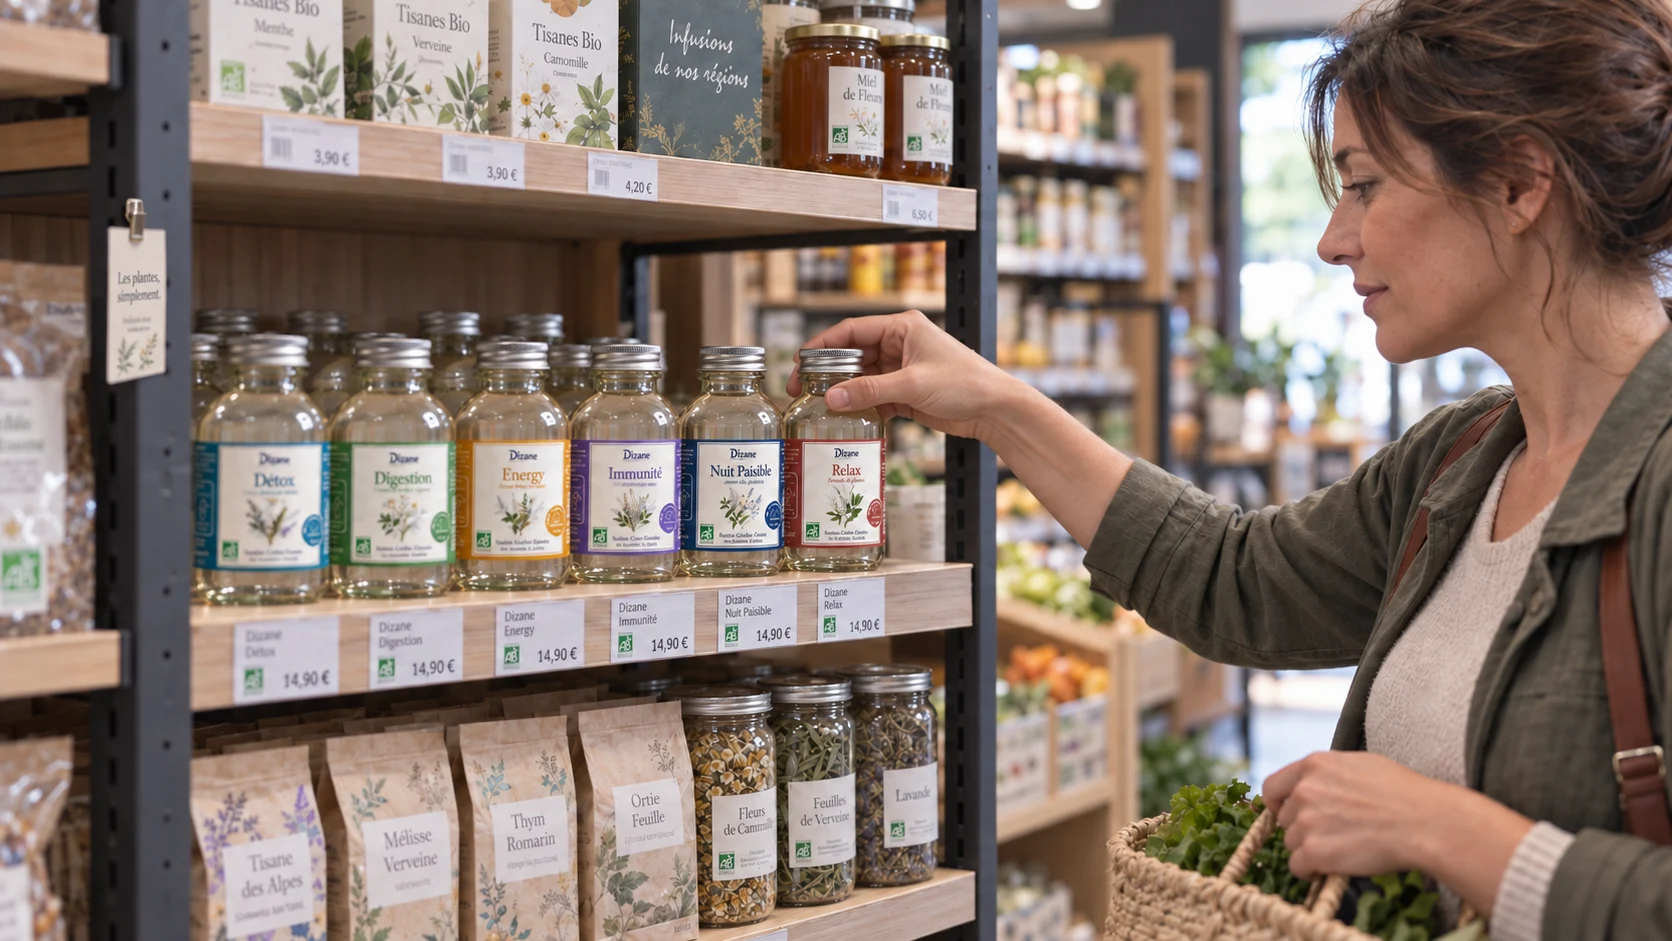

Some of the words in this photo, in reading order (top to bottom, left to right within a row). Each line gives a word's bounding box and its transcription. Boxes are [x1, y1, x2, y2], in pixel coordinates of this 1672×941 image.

[396, 3, 446, 30] Tisanes
[449, 12, 470, 33] Bio
[254, 18, 294, 37] Menthe
[412, 35, 452, 53] Verveine
[532, 22, 579, 47] Tisanes
[582, 30, 602, 51] Bio
[669, 19, 734, 56] Infusions
[543, 51, 589, 69] Camomille
[654, 52, 670, 75] de
[674, 66, 700, 81] nos
[857, 74, 877, 88] Miel
[843, 87, 856, 101] de
[858, 89, 883, 104] Fleurs
[930, 83, 948, 97] Miel
[916, 96, 929, 110] de
[314, 149, 339, 166] 3,90
[341, 153, 351, 166] €
[487, 166, 509, 181] 3,90
[510, 168, 518, 181] €
[625, 180, 646, 195] 4,20
[646, 182, 653, 194] €
[927, 210, 934, 222] €
[117, 271, 131, 285] Les
[132, 270, 160, 287] plantes,
[117, 289, 161, 305] simplement.
[258, 451, 291, 466] Dizane
[389, 451, 420, 465] Dizane
[509, 449, 538, 461] Dizane
[623, 448, 651, 460] Dizane
[730, 448, 757, 459] Dizane
[834, 448, 859, 459] Dizane
[502, 467, 545, 484] Energy
[608, 467, 663, 480] Immunité
[710, 464, 735, 478] Nuit
[737, 464, 772, 478] Paisible
[832, 463, 861, 477] Relax
[254, 472, 296, 489] Détox
[374, 470, 432, 489] Digestion
[725, 595, 752, 605] Dizane
[824, 588, 848, 597] Dizane
[619, 602, 647, 613] Dizane
[725, 608, 742, 618] Nuit
[743, 606, 772, 617] Paisible
[824, 600, 843, 610] Relax
[504, 611, 535, 622] Dizane
[619, 614, 658, 626] Immunité
[379, 621, 412, 633] Dizane
[504, 625, 535, 637] Energy
[849, 619, 873, 633] 14,90
[874, 618, 880, 630] €
[245, 630, 282, 643] Dizane
[757, 628, 783, 642] 14,90
[784, 627, 791, 639] €
[379, 636, 423, 650] Digestion
[651, 638, 679, 652] 14,90
[681, 636, 688, 648] €
[245, 647, 275, 659] Détox
[537, 648, 567, 664] 14,90
[569, 647, 577, 659] €
[412, 661, 444, 677] 14,90
[447, 659, 455, 673] €
[284, 671, 318, 688] 14,90
[321, 670, 330, 684] €
[631, 793, 660, 808] Ortie
[896, 785, 931, 802] Lavande
[814, 795, 847, 809] Feuilles
[632, 811, 665, 828] Feuille
[739, 807, 766, 820] Fleurs
[801, 814, 812, 826] de
[815, 811, 850, 825] Verveine
[511, 813, 546, 831] Thym
[724, 824, 736, 836] de
[384, 829, 432, 850] Mélisse
[507, 832, 556, 852] Romarin
[249, 853, 293, 872] Tisane
[384, 853, 438, 873] Verveine
[242, 880, 264, 899] des
[266, 875, 304, 895] Alpes
